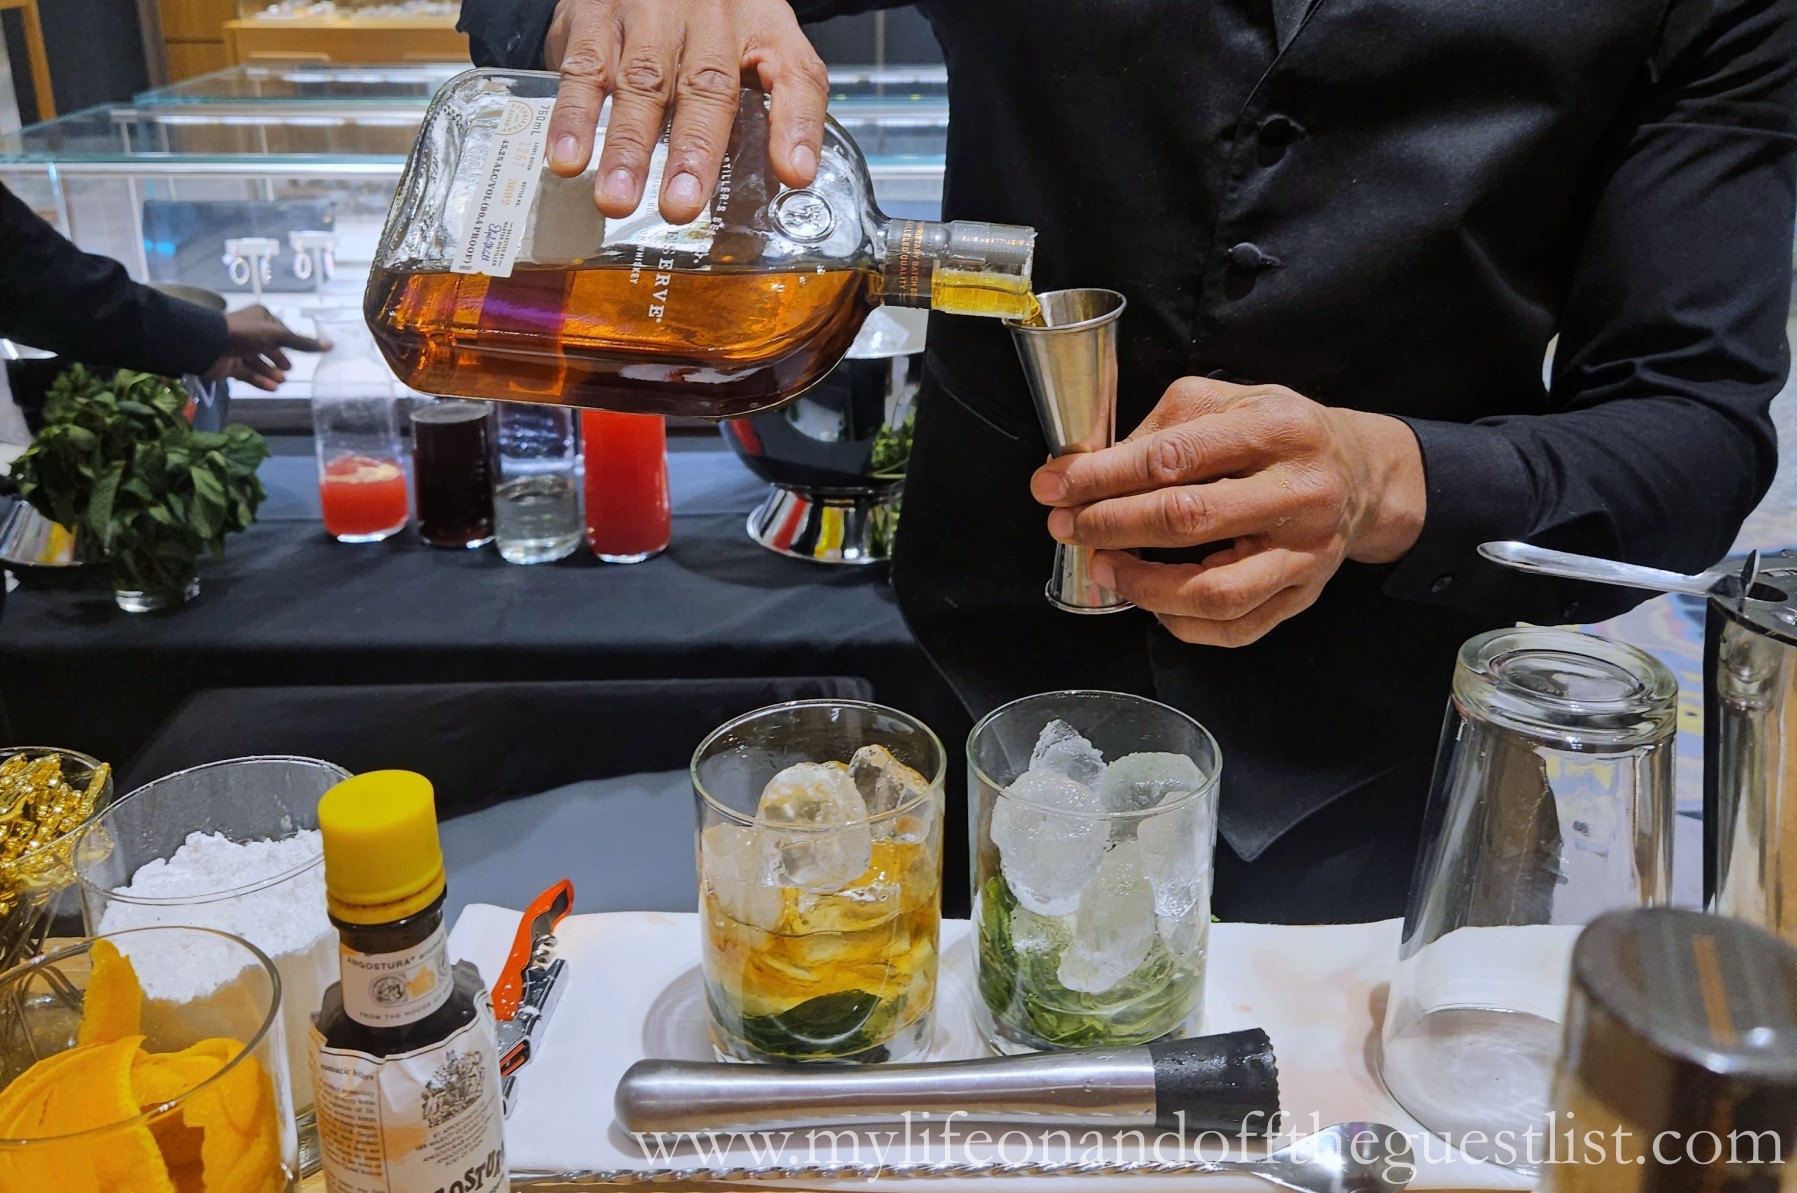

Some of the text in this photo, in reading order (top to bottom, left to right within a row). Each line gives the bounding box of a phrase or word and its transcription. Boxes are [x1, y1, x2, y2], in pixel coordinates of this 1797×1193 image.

[530, 103, 550, 137] 750mL
[482, 162, 502, 202] ALC/VOL
[716, 152, 731, 212] STILLER'S
[475, 202, 490, 226] (90.4
[462, 226, 481, 265] PROOF)
[630, 245, 644, 284] WHISKEY
[648, 231, 678, 322] ESERVE
[899, 254, 908, 289] QUALITY
